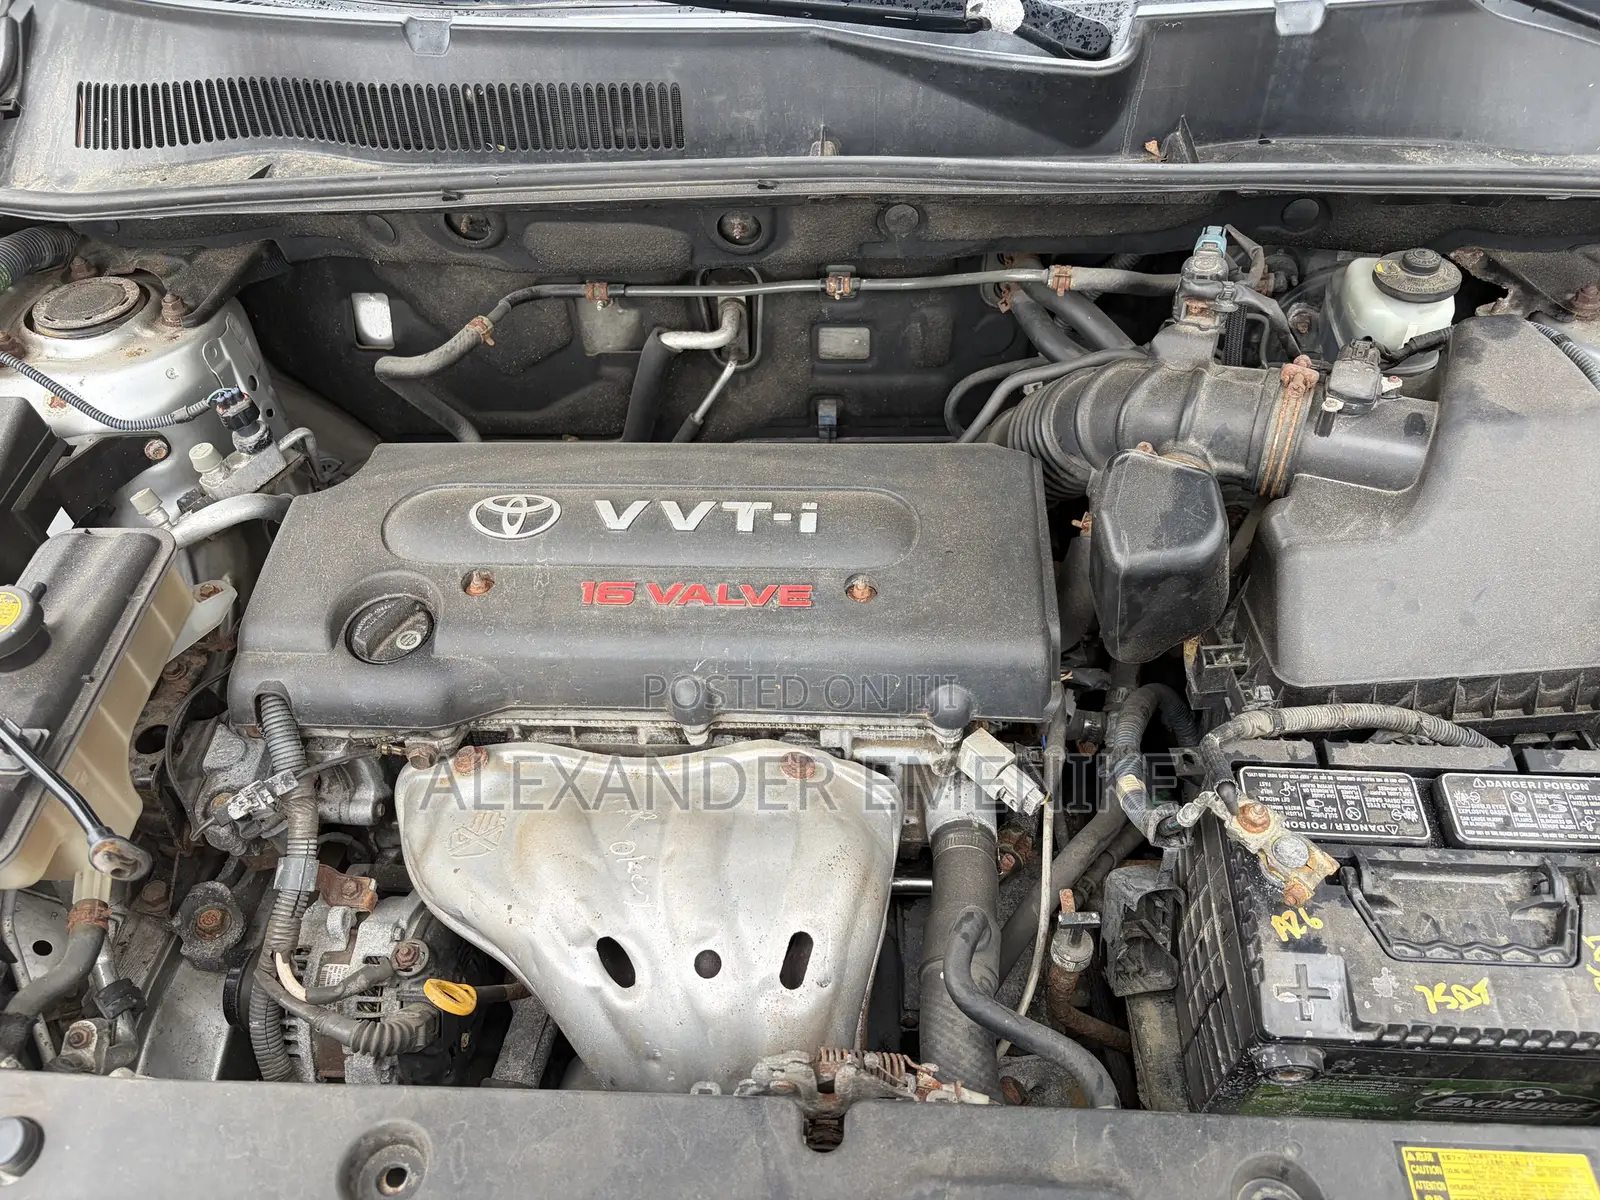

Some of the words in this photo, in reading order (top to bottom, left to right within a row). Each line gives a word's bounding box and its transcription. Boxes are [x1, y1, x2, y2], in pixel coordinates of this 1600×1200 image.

[594, 500, 818, 533] VVT-i
[581, 581, 637, 606] 16
[647, 582, 813, 608] VALVE
[1486, 780, 1537, 790] DANGER
[1543, 781, 1590, 791] POISON
[1334, 822, 1386, 833] DANGER
[1411, 1164, 1443, 1175] CAUTION
